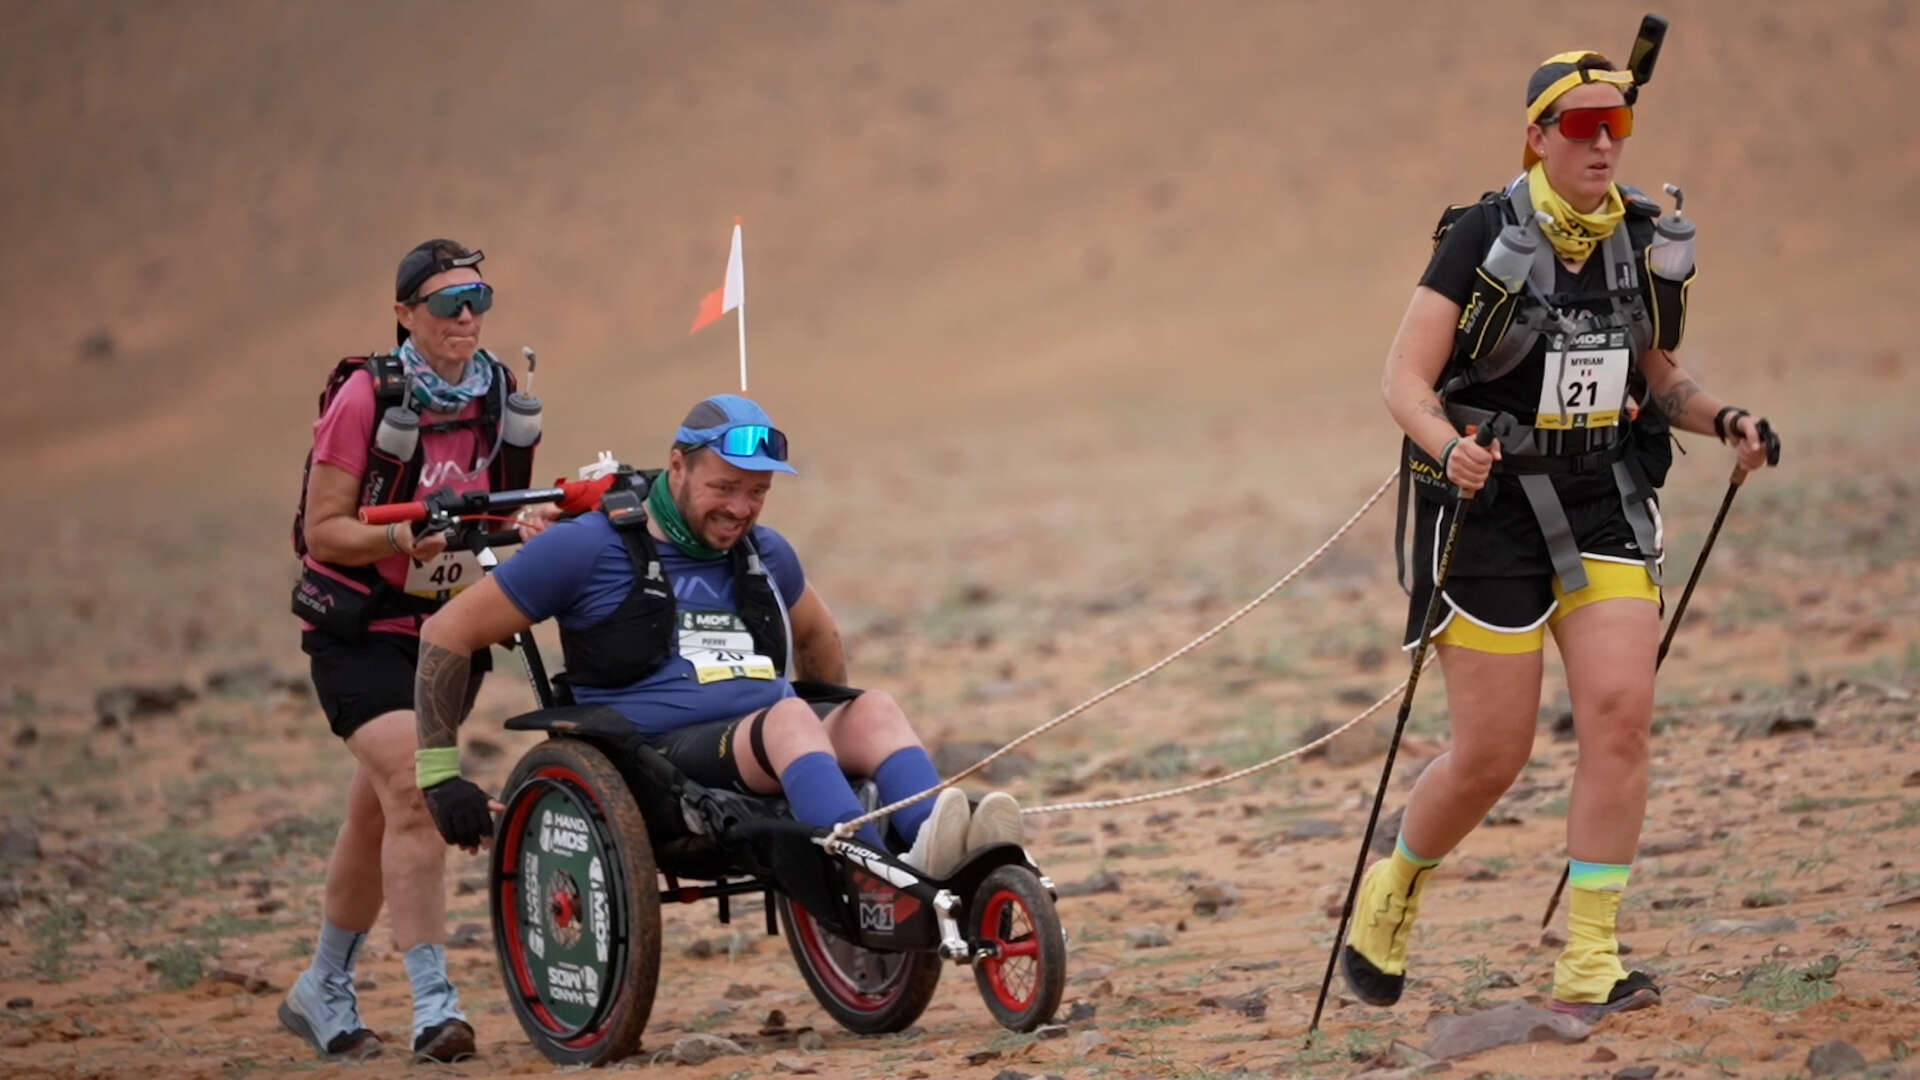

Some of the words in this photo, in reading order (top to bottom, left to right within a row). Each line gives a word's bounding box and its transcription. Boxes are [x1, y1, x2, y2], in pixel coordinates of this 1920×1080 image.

[1571, 357, 1604, 366] MYRIAM
[1566, 381, 1598, 407] 21
[429, 562, 462, 585] 40
[696, 614, 730, 626] MDS
[702, 638, 727, 647] PIERRE
[553, 828, 589, 852] MDS
[594, 891, 608, 962] MDS
[859, 902, 895, 930] M1
[548, 966, 582, 990] MDS
